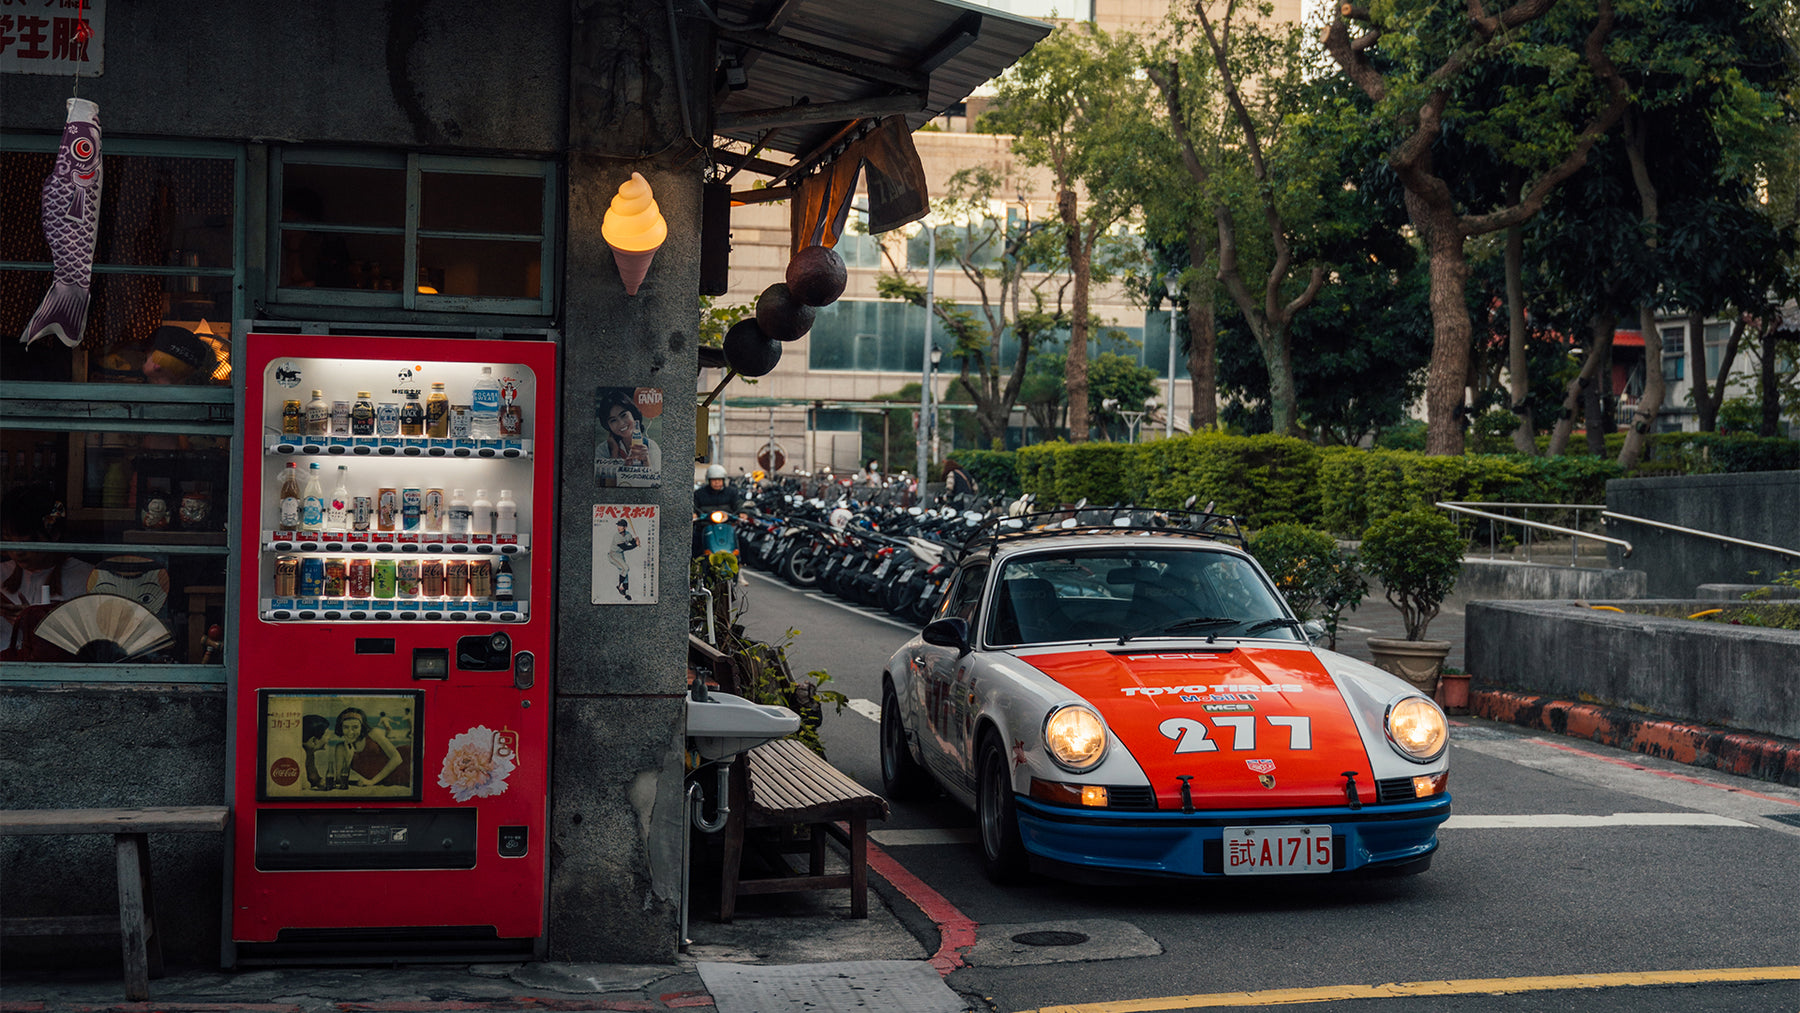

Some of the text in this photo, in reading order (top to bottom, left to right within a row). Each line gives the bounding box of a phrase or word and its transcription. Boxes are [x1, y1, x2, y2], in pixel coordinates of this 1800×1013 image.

[638, 393, 663, 404] FANTA
[605, 506, 655, 518] ベースボール
[1120, 684, 1303, 696] TOYO TIRES
[1179, 694, 1237, 702] Mobil
[271, 719, 300, 728] コカ・コーラ
[1158, 715, 1312, 754] 277
[272, 767, 298, 777] Coca-Cola
